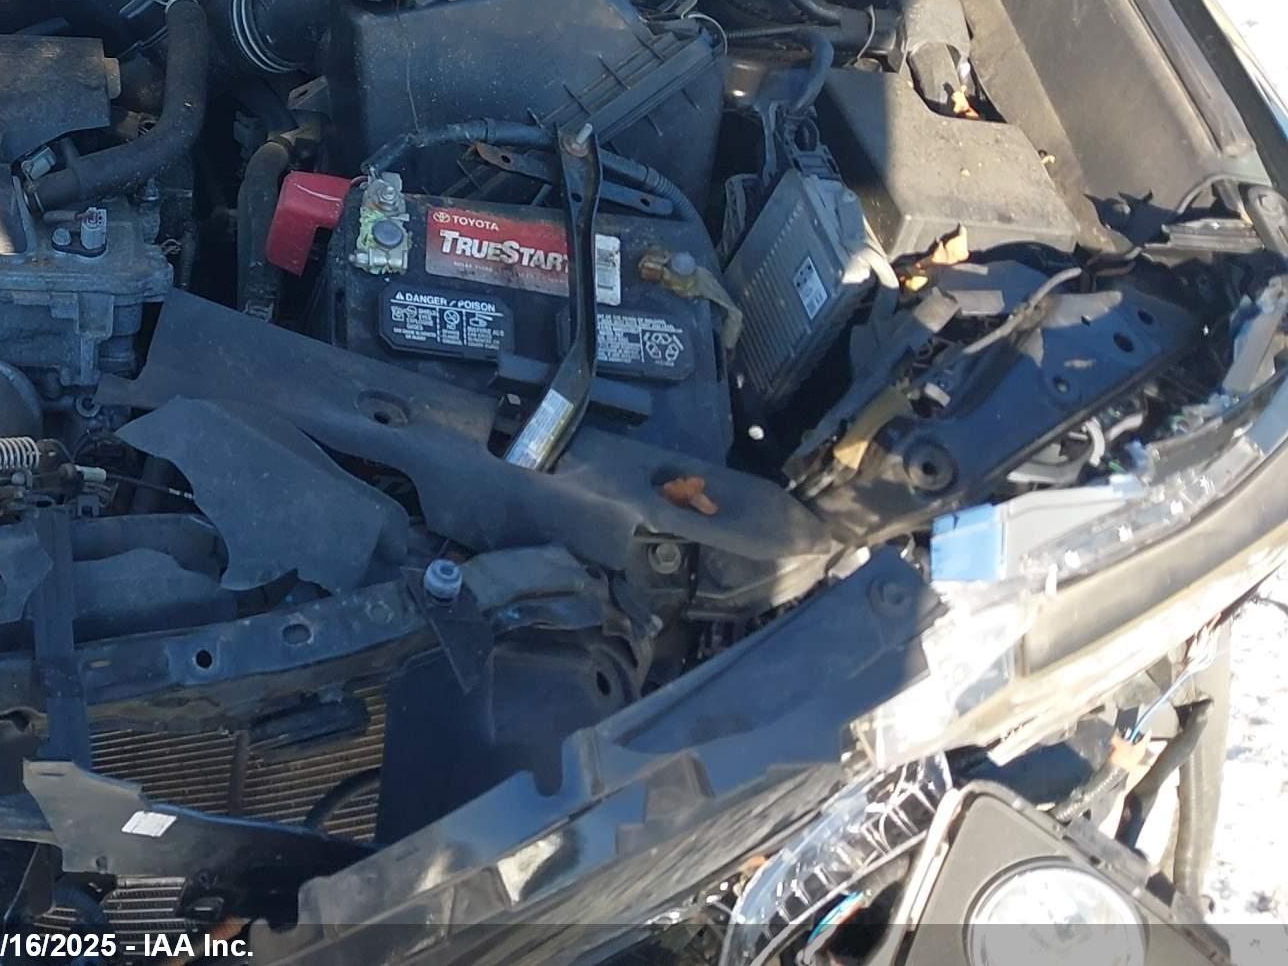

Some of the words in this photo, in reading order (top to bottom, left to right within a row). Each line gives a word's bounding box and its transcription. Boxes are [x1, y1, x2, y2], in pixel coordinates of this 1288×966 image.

[453, 215, 500, 232] TOYOTA
[405, 292, 448, 306] DANGER
[457, 299, 496, 312] POISON
